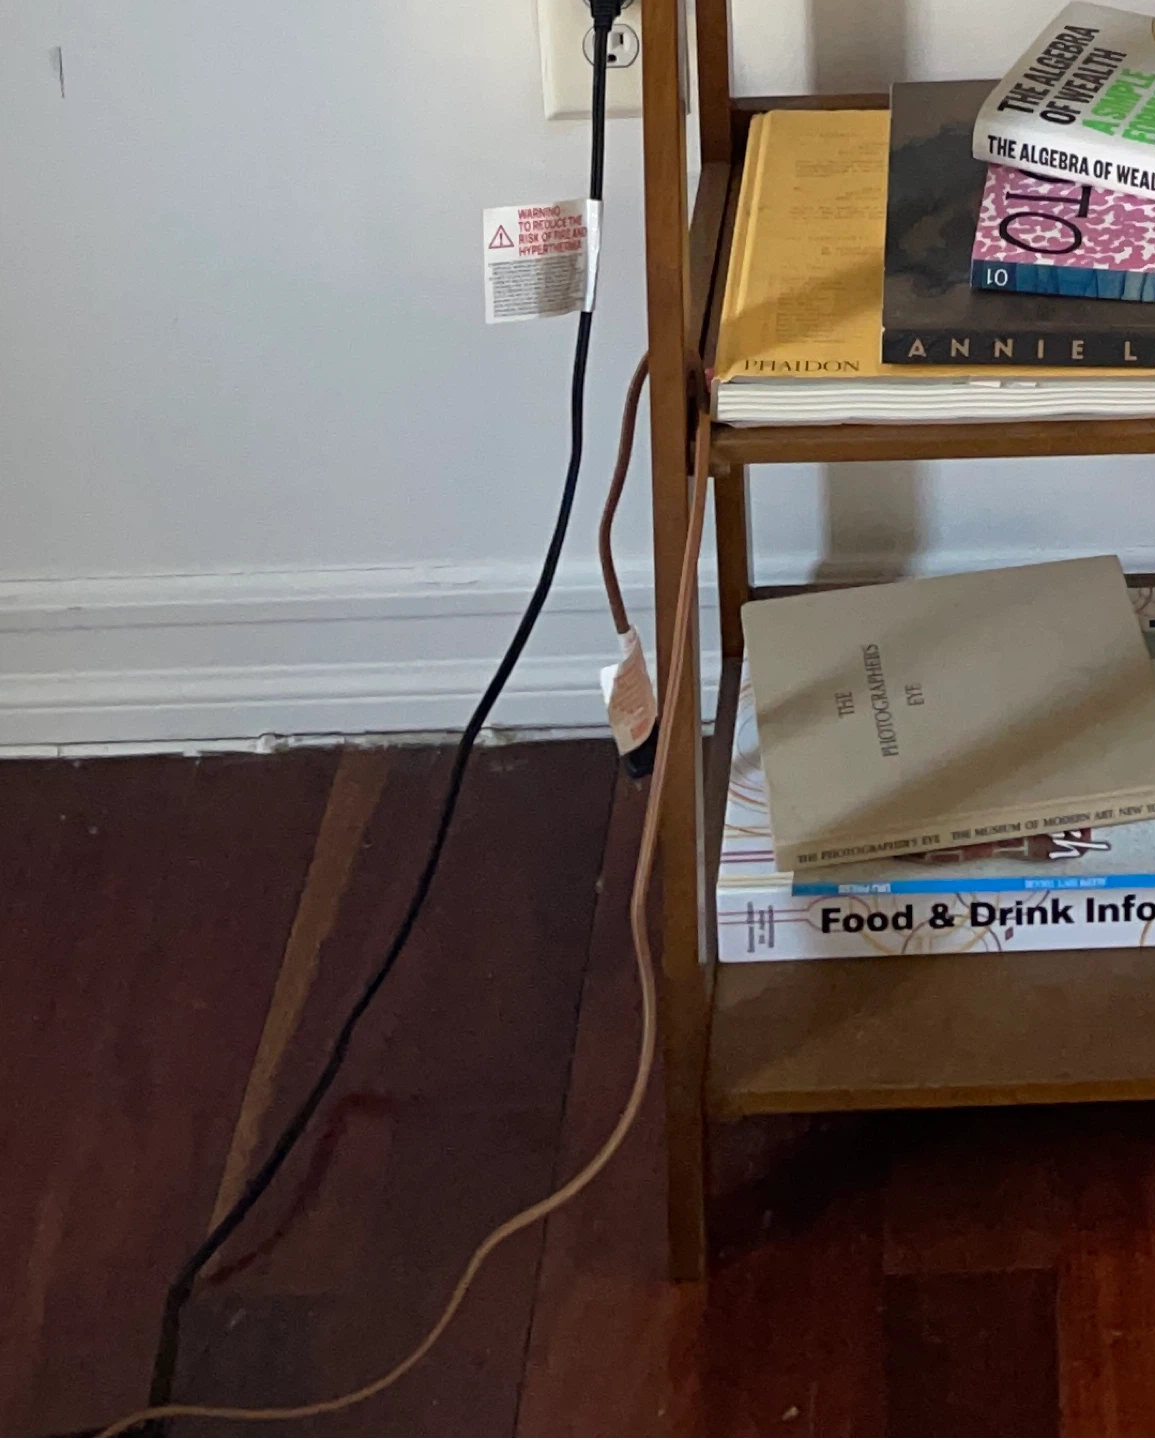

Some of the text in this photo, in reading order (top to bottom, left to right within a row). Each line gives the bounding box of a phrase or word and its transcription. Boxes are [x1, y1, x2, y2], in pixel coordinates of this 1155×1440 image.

[996, 24, 1101, 114] THE ALGEBRA
[1039, 47, 1128, 125] OF WEALTH
[1081, 118, 1121, 137] A
[987, 134, 1016, 160] THE
[1019, 142, 1089, 177] ALGEBRA
[1093, 159, 1114, 181] OF
[518, 205, 560, 219] WARNING
[518, 221, 531, 232] TO
[533, 218, 567, 231] REDUCE
[519, 233, 538, 245] RISK
[541, 231, 552, 242] OF
[907, 337, 1086, 361] ANNIE
[744, 360, 860, 372] PHAIDON
[834, 691, 855, 719] THE
[905, 683, 925, 707] EYE
[797, 854, 819, 864] THE
[921, 834, 941, 846] EYE
[952, 828, 972, 840] THE
[974, 821, 1022, 837] MUSEUM
[1024, 819, 1040, 831] OF
[1043, 812, 1091, 827] MODERN
[1118, 804, 1144, 817] NEW
[821, 904, 914, 934] Food
[928, 902, 955, 930] &
[969, 897, 1075, 928] Drink
